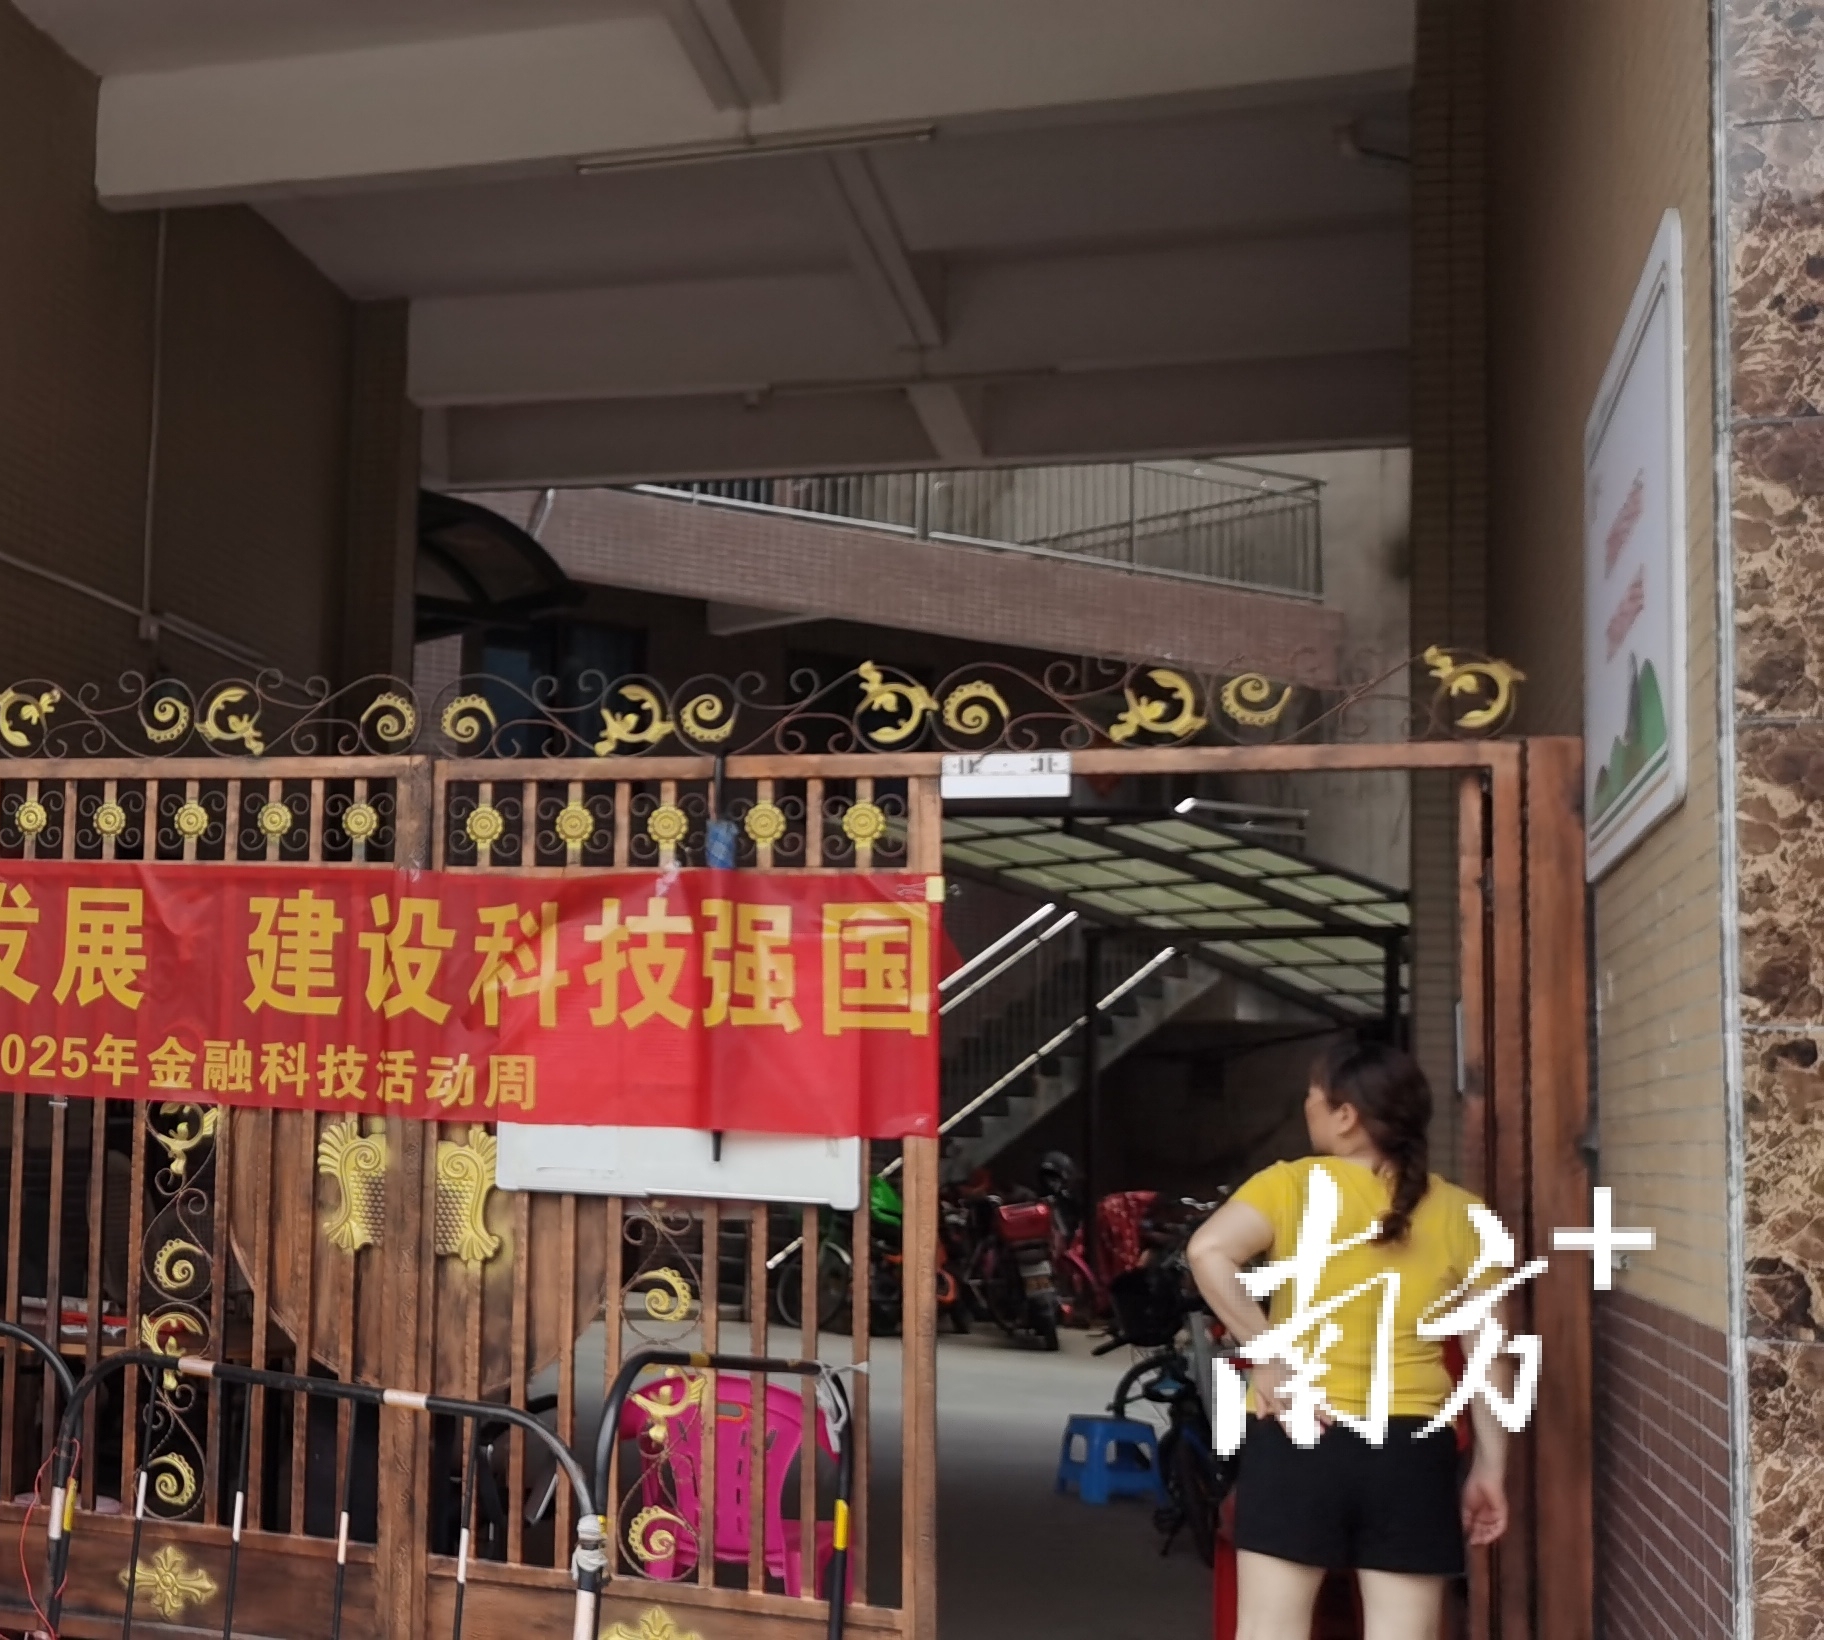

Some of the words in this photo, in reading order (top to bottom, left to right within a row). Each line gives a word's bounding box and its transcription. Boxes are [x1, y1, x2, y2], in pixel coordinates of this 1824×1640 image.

[242, 888, 931, 1037] 建设科技强国
